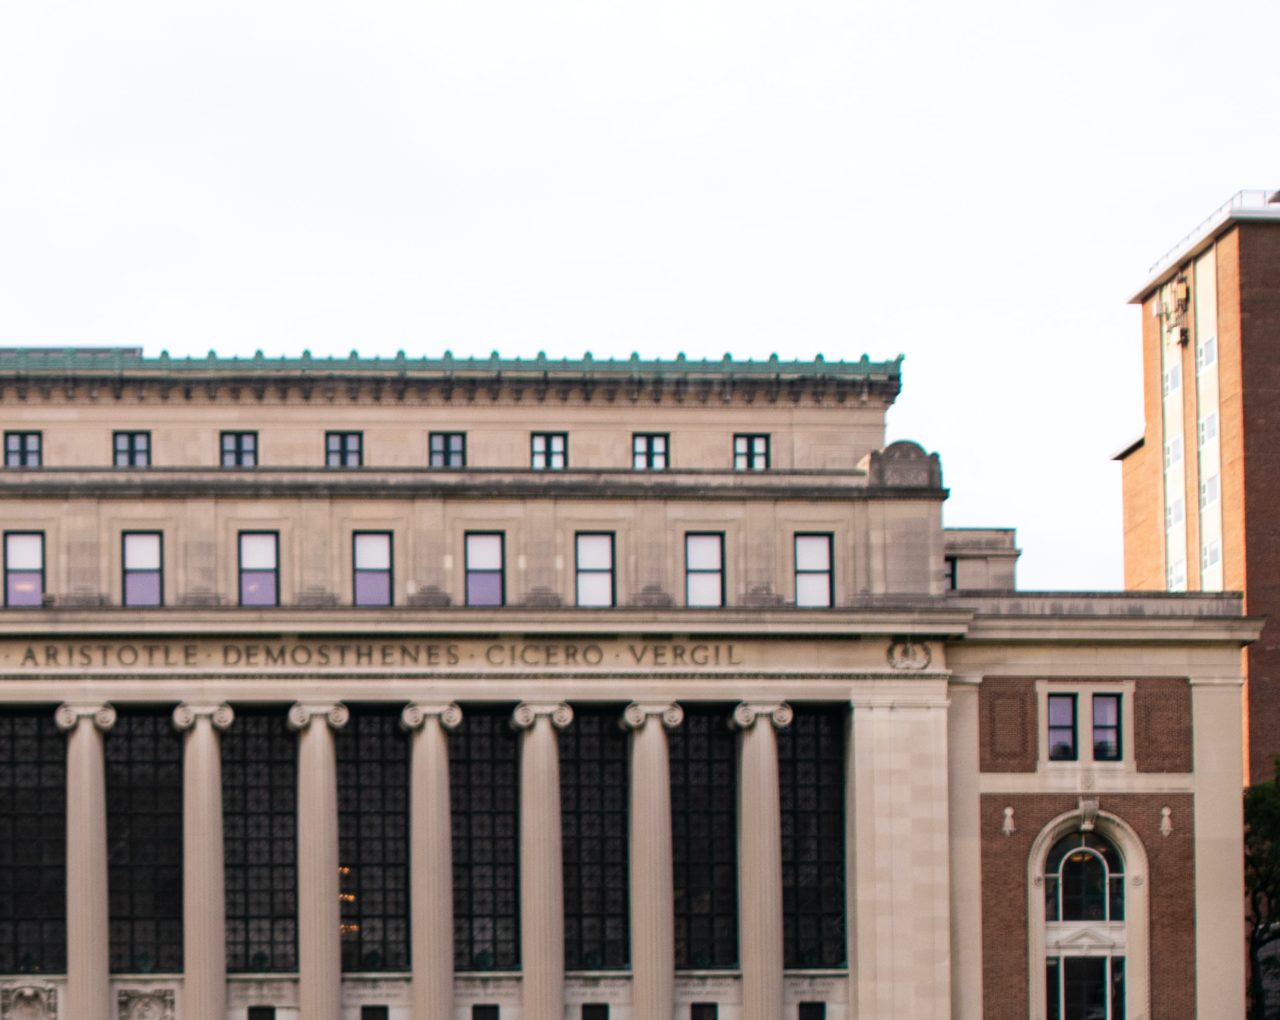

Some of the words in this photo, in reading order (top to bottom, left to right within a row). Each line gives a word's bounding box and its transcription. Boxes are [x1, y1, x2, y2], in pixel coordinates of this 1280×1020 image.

[21, 644, 199, 667] ARISTOTLE
[222, 644, 460, 667] DEMOSTHENES
[485, 643, 604, 666] CICERO
[629, 643, 742, 666] VERGIL
